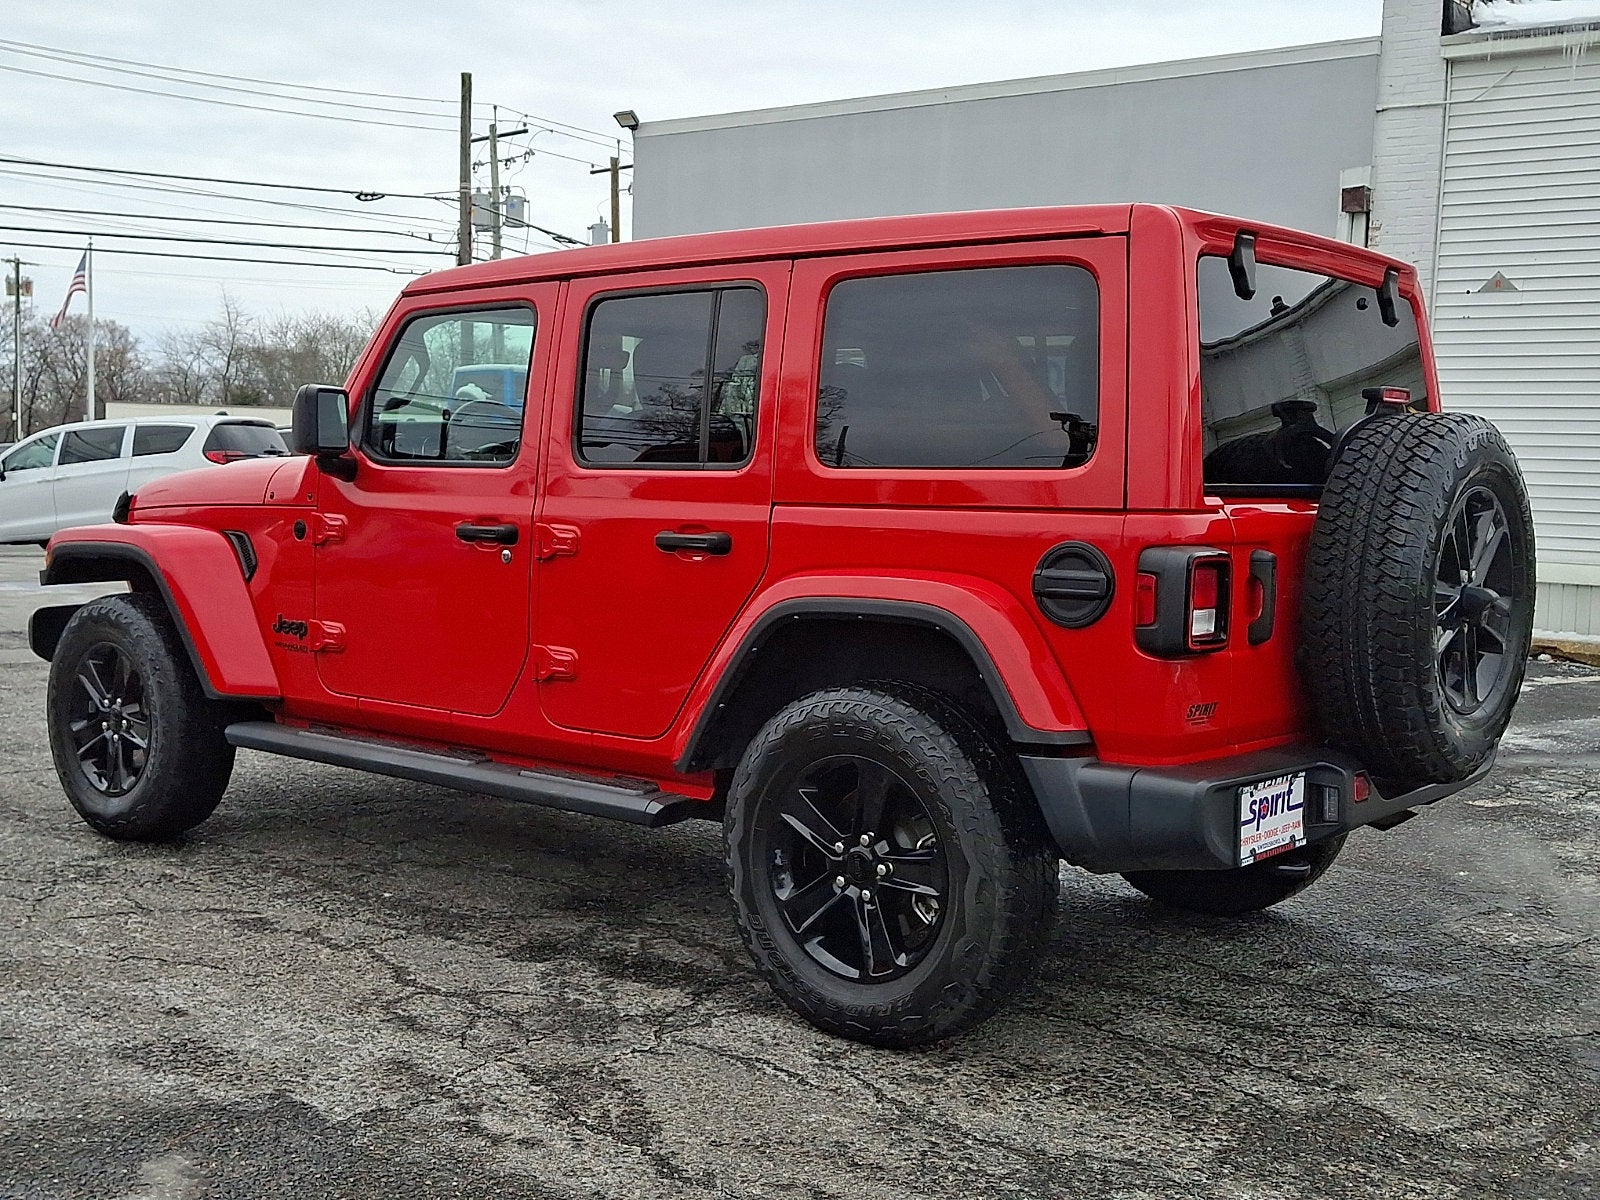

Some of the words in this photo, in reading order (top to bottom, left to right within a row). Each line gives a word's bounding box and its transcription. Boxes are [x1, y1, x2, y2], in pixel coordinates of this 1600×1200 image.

[272, 613, 308, 640] Jeep
[1186, 702, 1218, 718] SPIRIT
[1257, 774, 1292, 788] SPIRIT
[746, 912, 913, 1018] BRIDGESTONE
